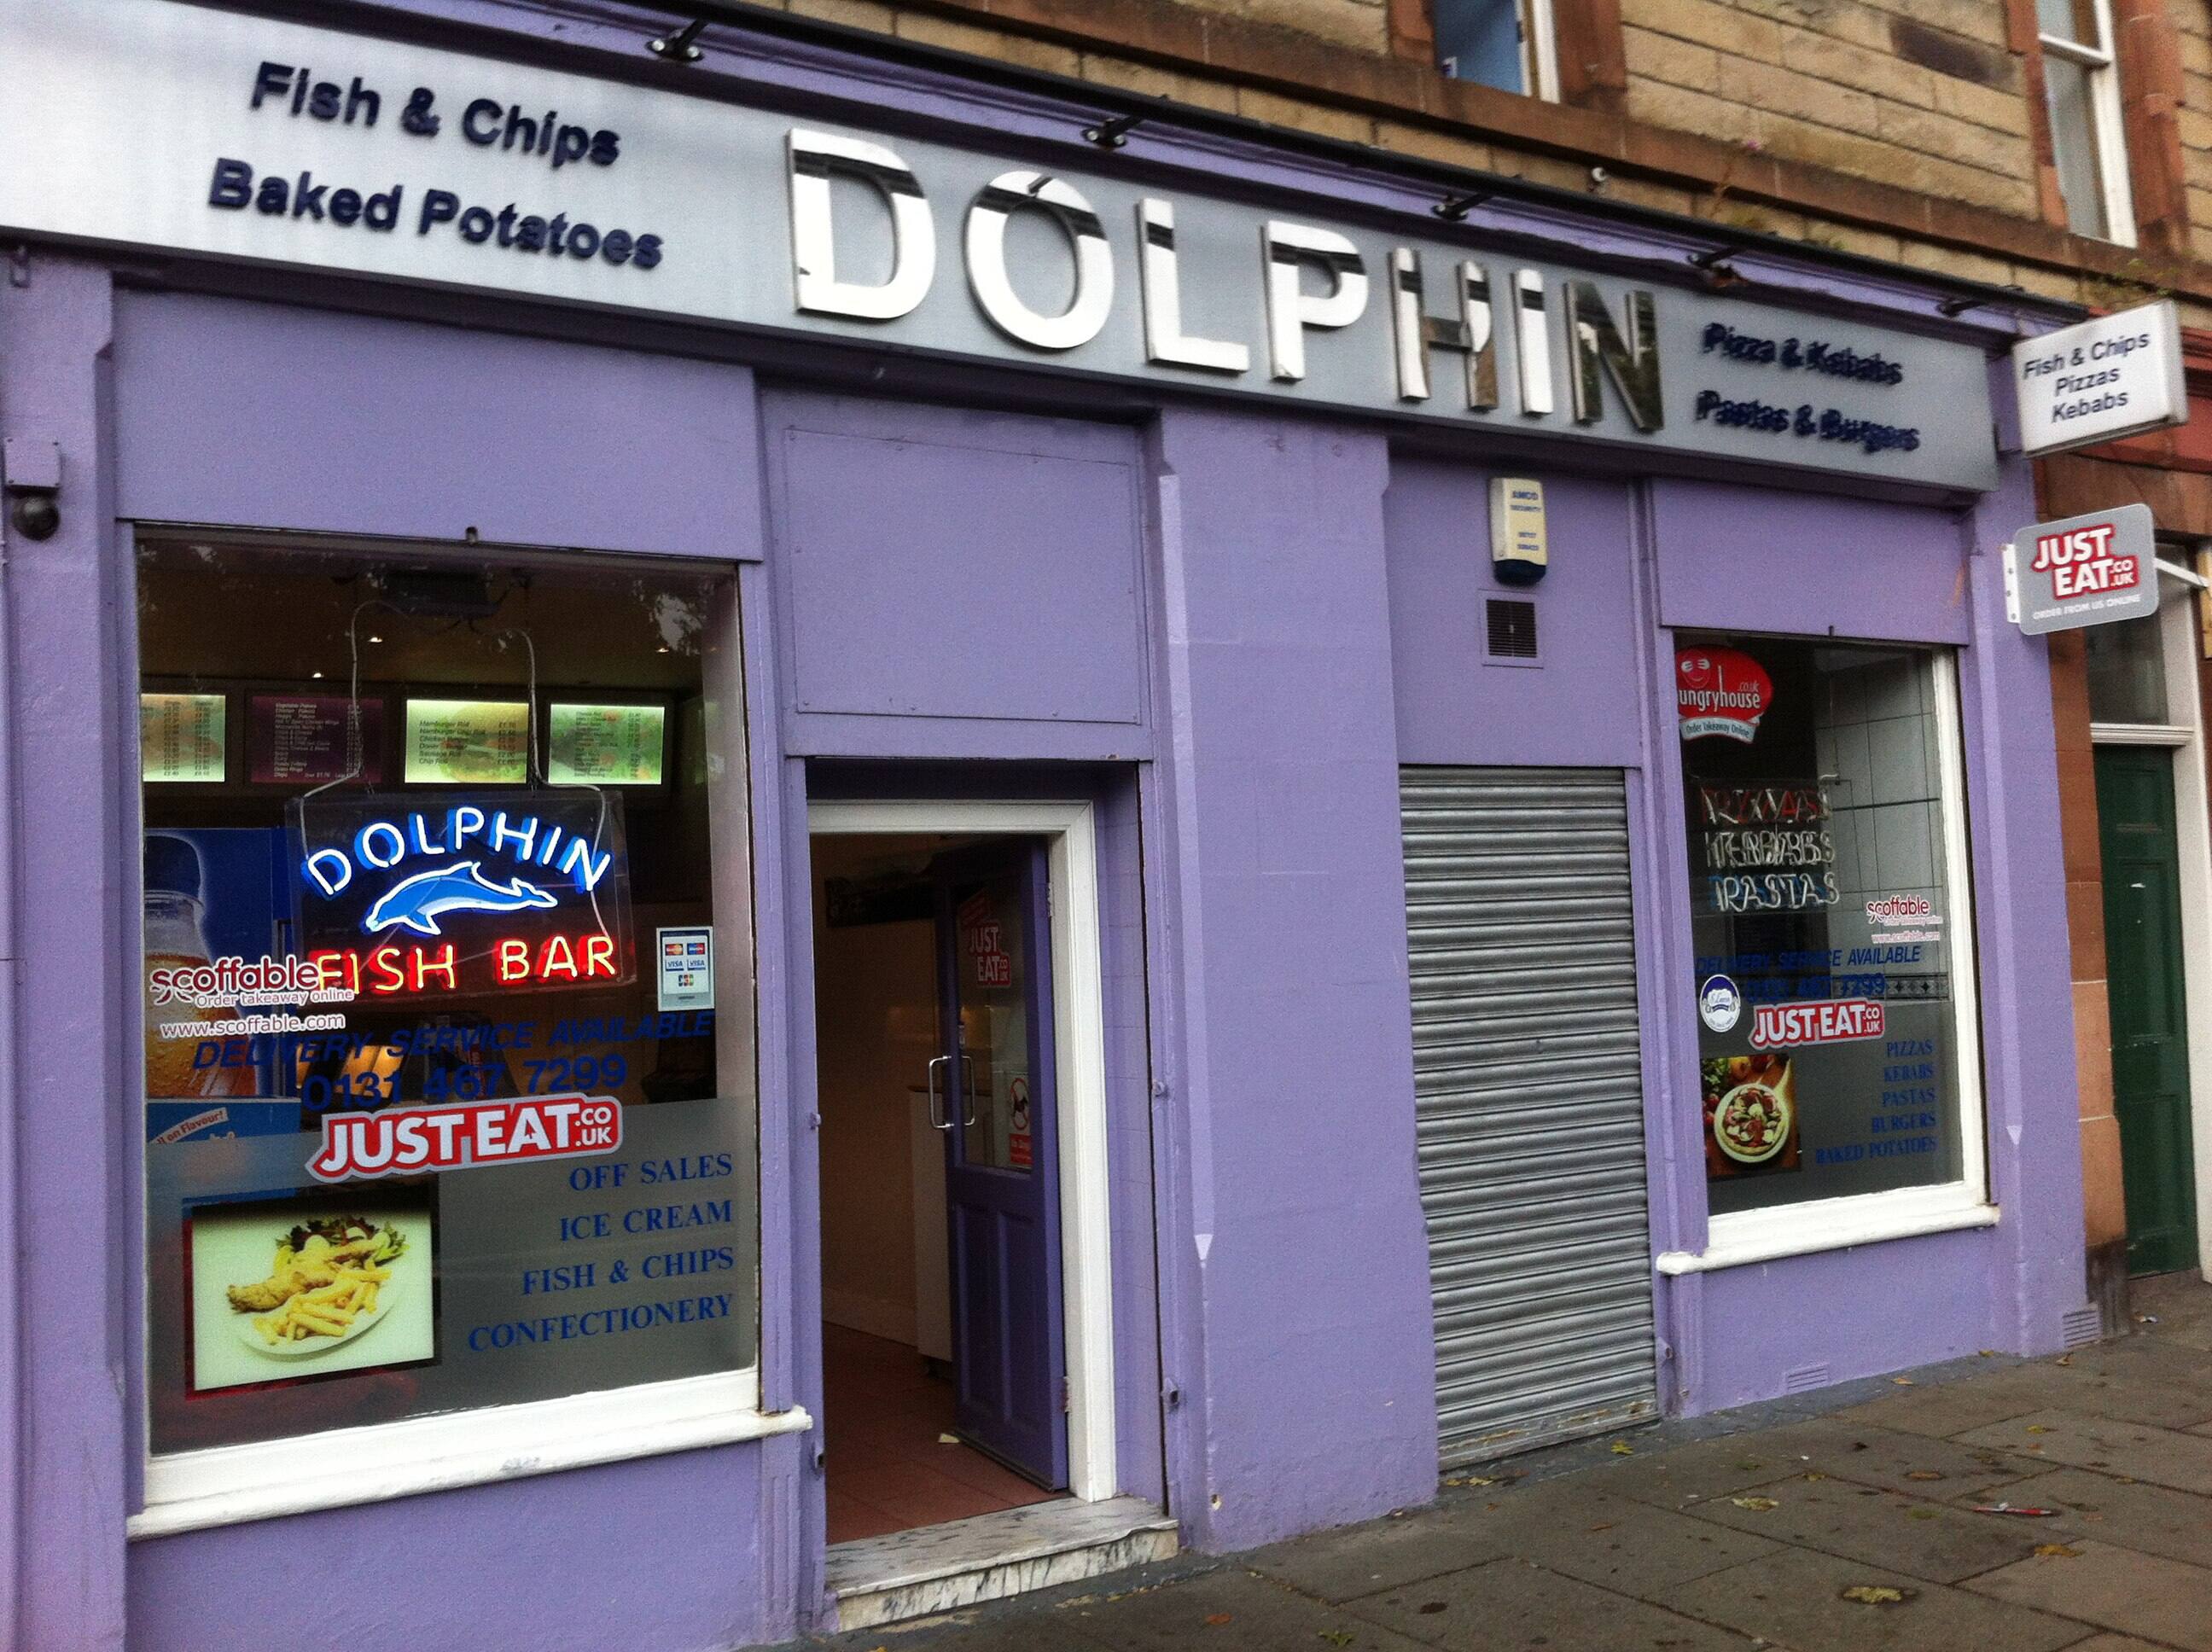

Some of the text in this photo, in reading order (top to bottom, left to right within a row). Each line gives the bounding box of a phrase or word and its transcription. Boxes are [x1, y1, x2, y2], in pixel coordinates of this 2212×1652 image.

[251, 61, 620, 169] Fish & Chips
[208, 158, 664, 270] Baked Potatoes
[788, 128, 1664, 432] DOLPHIN
[1703, 323, 1904, 386] Pizza & Kebabs
[2023, 331, 2150, 380] Fish & Chips
[2055, 368, 2121, 398] Pizzas
[1695, 390, 1790, 433] Pastas
[1792, 404, 1817, 436] &
[2052, 389, 2129, 423] Kebabs
[2034, 525, 2114, 570] JUST
[2054, 557, 2112, 597] EAT
[1678, 665, 1761, 713] ungryhouse
[303, 805, 612, 897] DOLPHIN
[1866, 894, 1930, 916] scoffable
[969, 926, 1000, 954] JUST
[1848, 945, 1922, 966] AVAILABLE
[151, 955, 319, 993] scoffable
[315, 935, 616, 992] FISH BAR
[977, 955, 999, 982] EAT
[196, 988, 354, 1008] Order takeaway online
[161, 1014, 346, 1038] www.scoffable.com
[193, 1010, 715, 1070] DELIVERY SERVICE AVAILABLE
[1755, 1008, 1817, 1043] JUST
[1819, 1004, 1866, 1037] EAT
[303, 1054, 627, 1110] 0131 467 7299
[320, 1114, 463, 1172] JUST
[476, 1103, 581, 1157] EAT
[569, 1153, 732, 1192] OFF SALES
[560, 1200, 732, 1242] ICE CREAM
[522, 1247, 734, 1295] FISH & CHIPS
[469, 1293, 733, 1352] CONFECTIONERY
